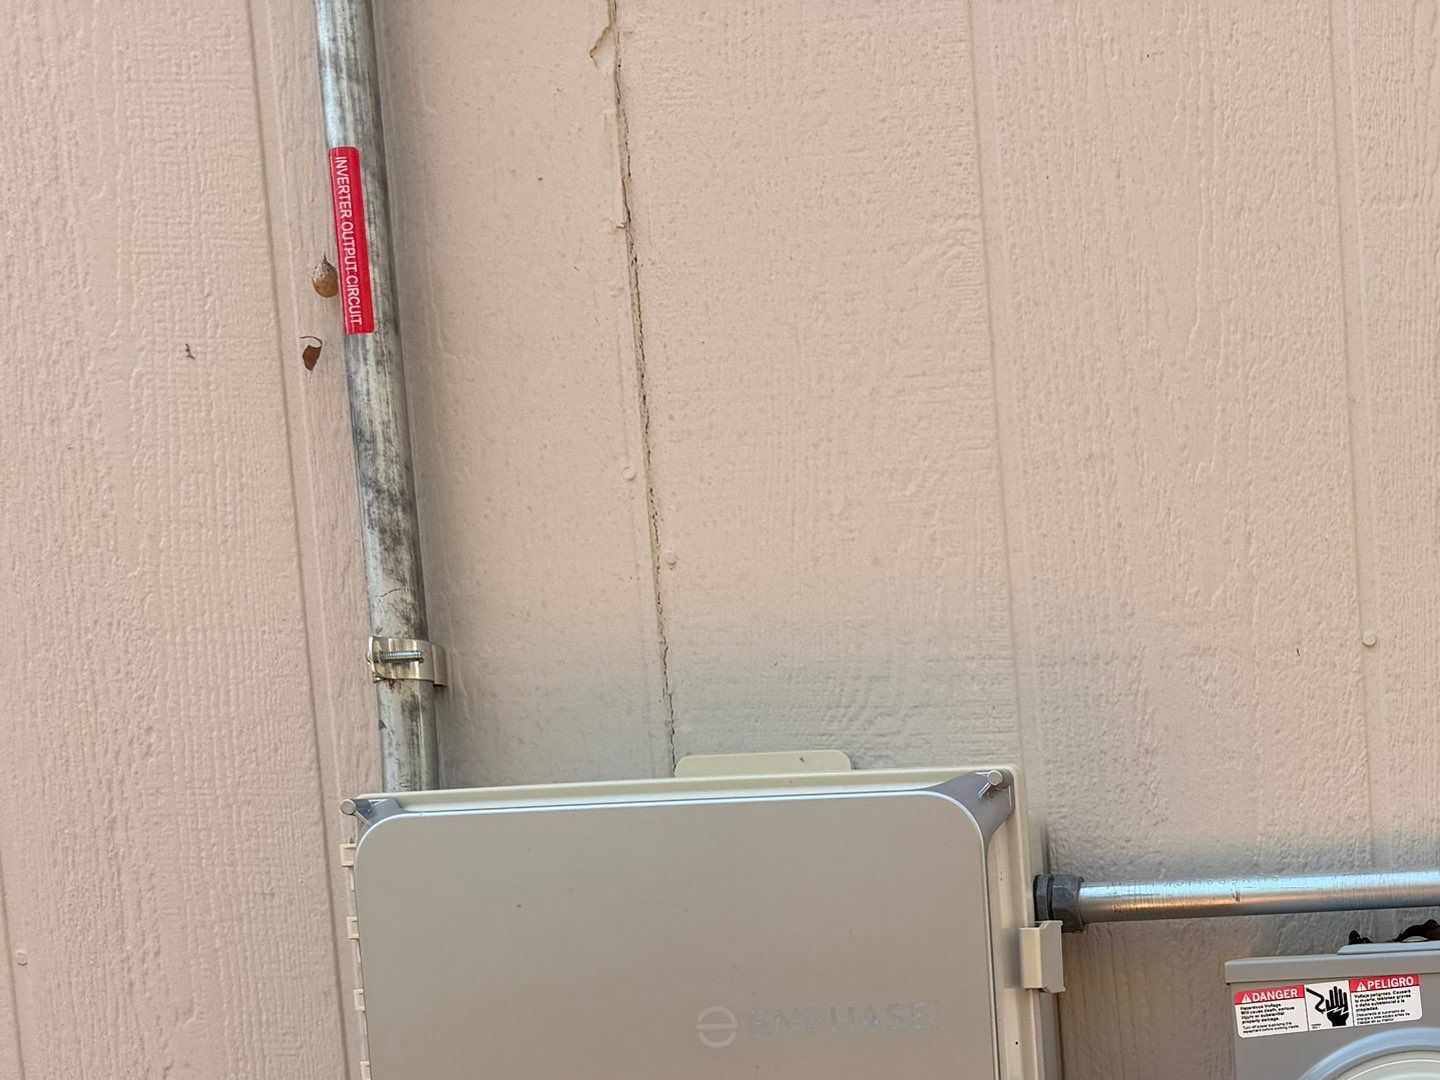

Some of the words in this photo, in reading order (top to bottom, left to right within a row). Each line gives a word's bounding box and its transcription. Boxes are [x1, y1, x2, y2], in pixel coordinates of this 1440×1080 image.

[335, 157, 352, 218] INVERTER
[342, 222, 356, 272] OUTPUT
[346, 275, 362, 325] CIRCUIT
[1252, 989, 1298, 1002] DANGER
[1367, 976, 1414, 990] PELIGRO
